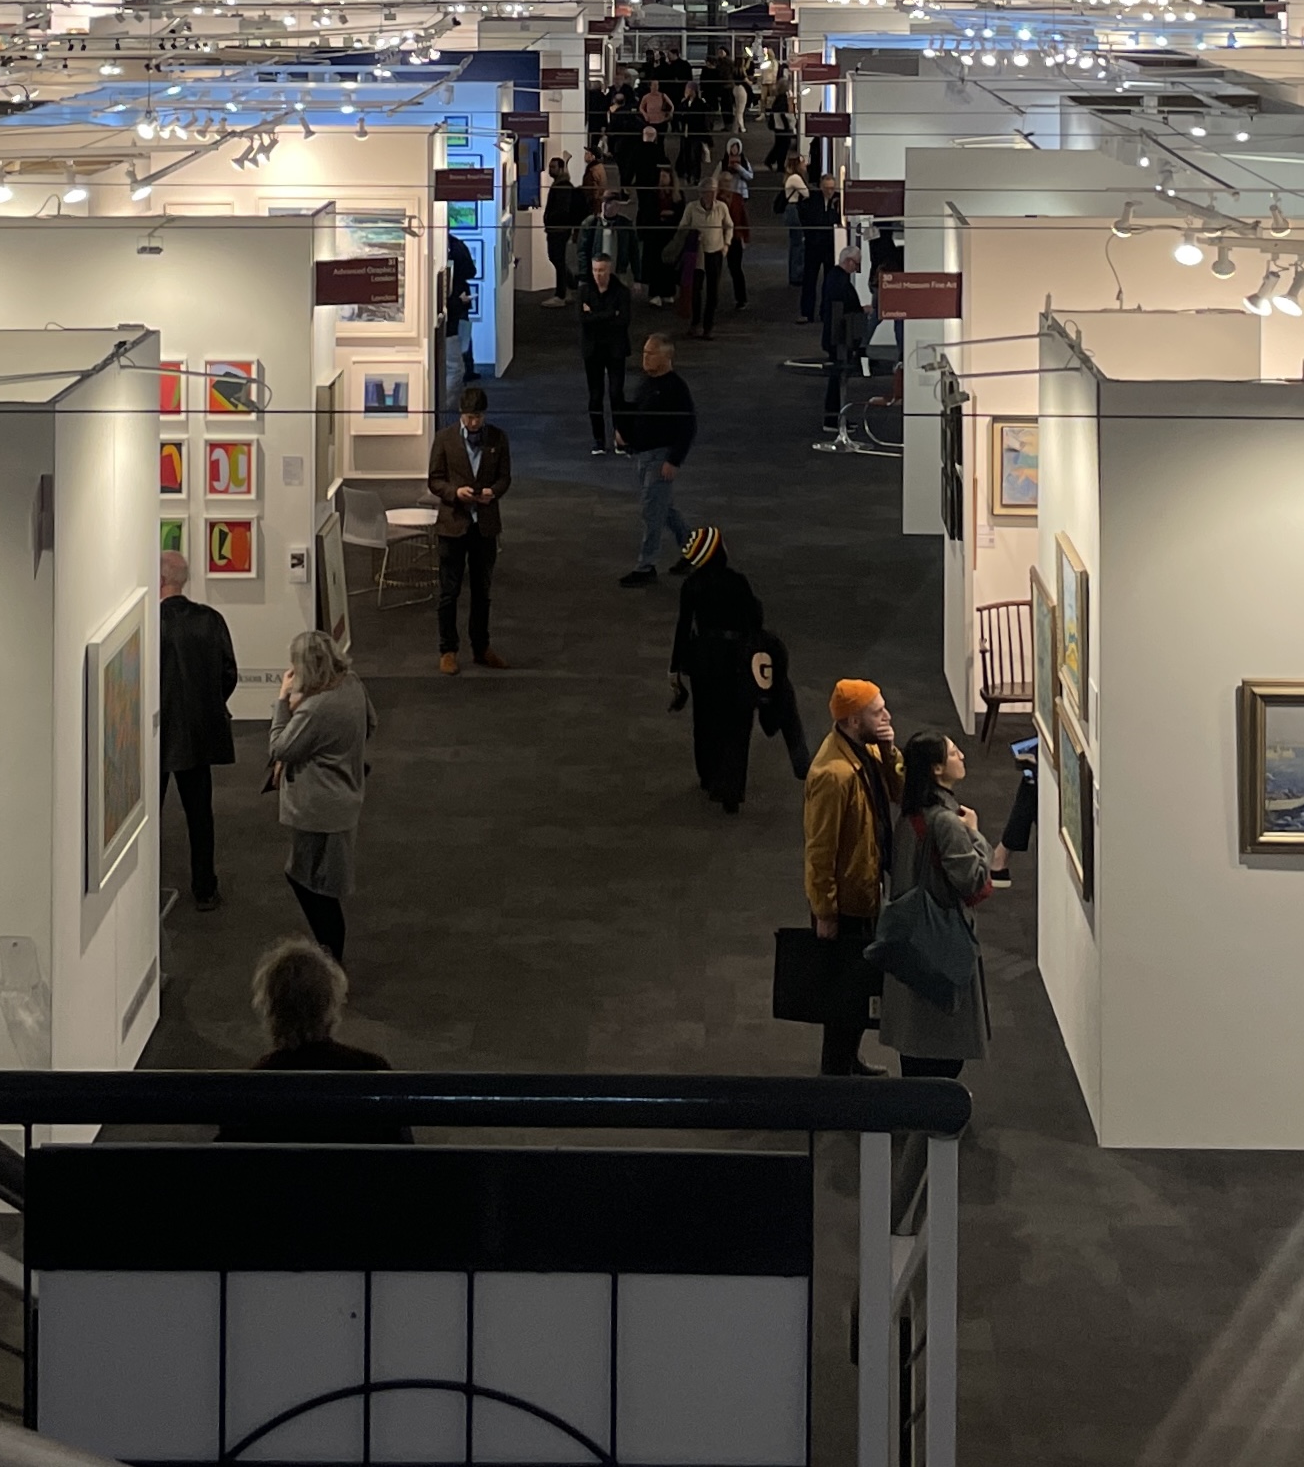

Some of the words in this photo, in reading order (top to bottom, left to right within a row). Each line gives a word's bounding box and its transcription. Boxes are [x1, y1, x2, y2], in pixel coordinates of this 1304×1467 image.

[333, 267, 366, 275] Advanced
[367, 265, 396, 275] Graphics
[371, 275, 397, 283] London
[882, 274, 893, 282] 30
[882, 281, 902, 289] David
[931, 280, 945, 289] Fine
[946, 280, 958, 289] Art
[371, 294, 397, 302] London
[882, 310, 907, 318] London
